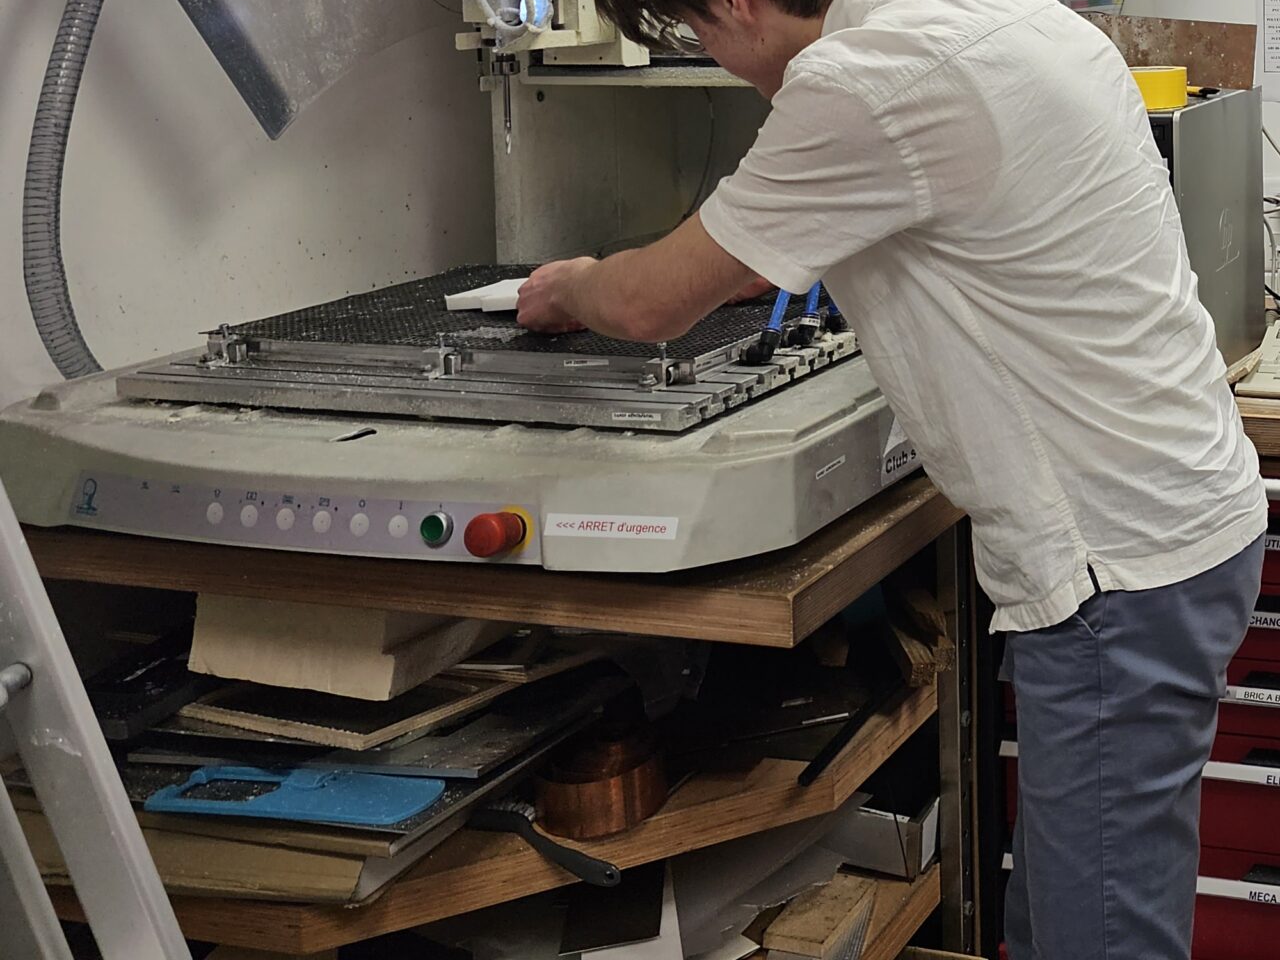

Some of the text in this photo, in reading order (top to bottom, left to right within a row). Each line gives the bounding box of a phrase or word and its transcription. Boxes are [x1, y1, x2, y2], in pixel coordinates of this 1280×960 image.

[886, 448, 916, 474] Club s
[578, 521, 616, 532] ARRET
[617, 522, 667, 536] d'urgence
[1244, 690, 1264, 700] BRIC
[1248, 890, 1278, 904] MECA
